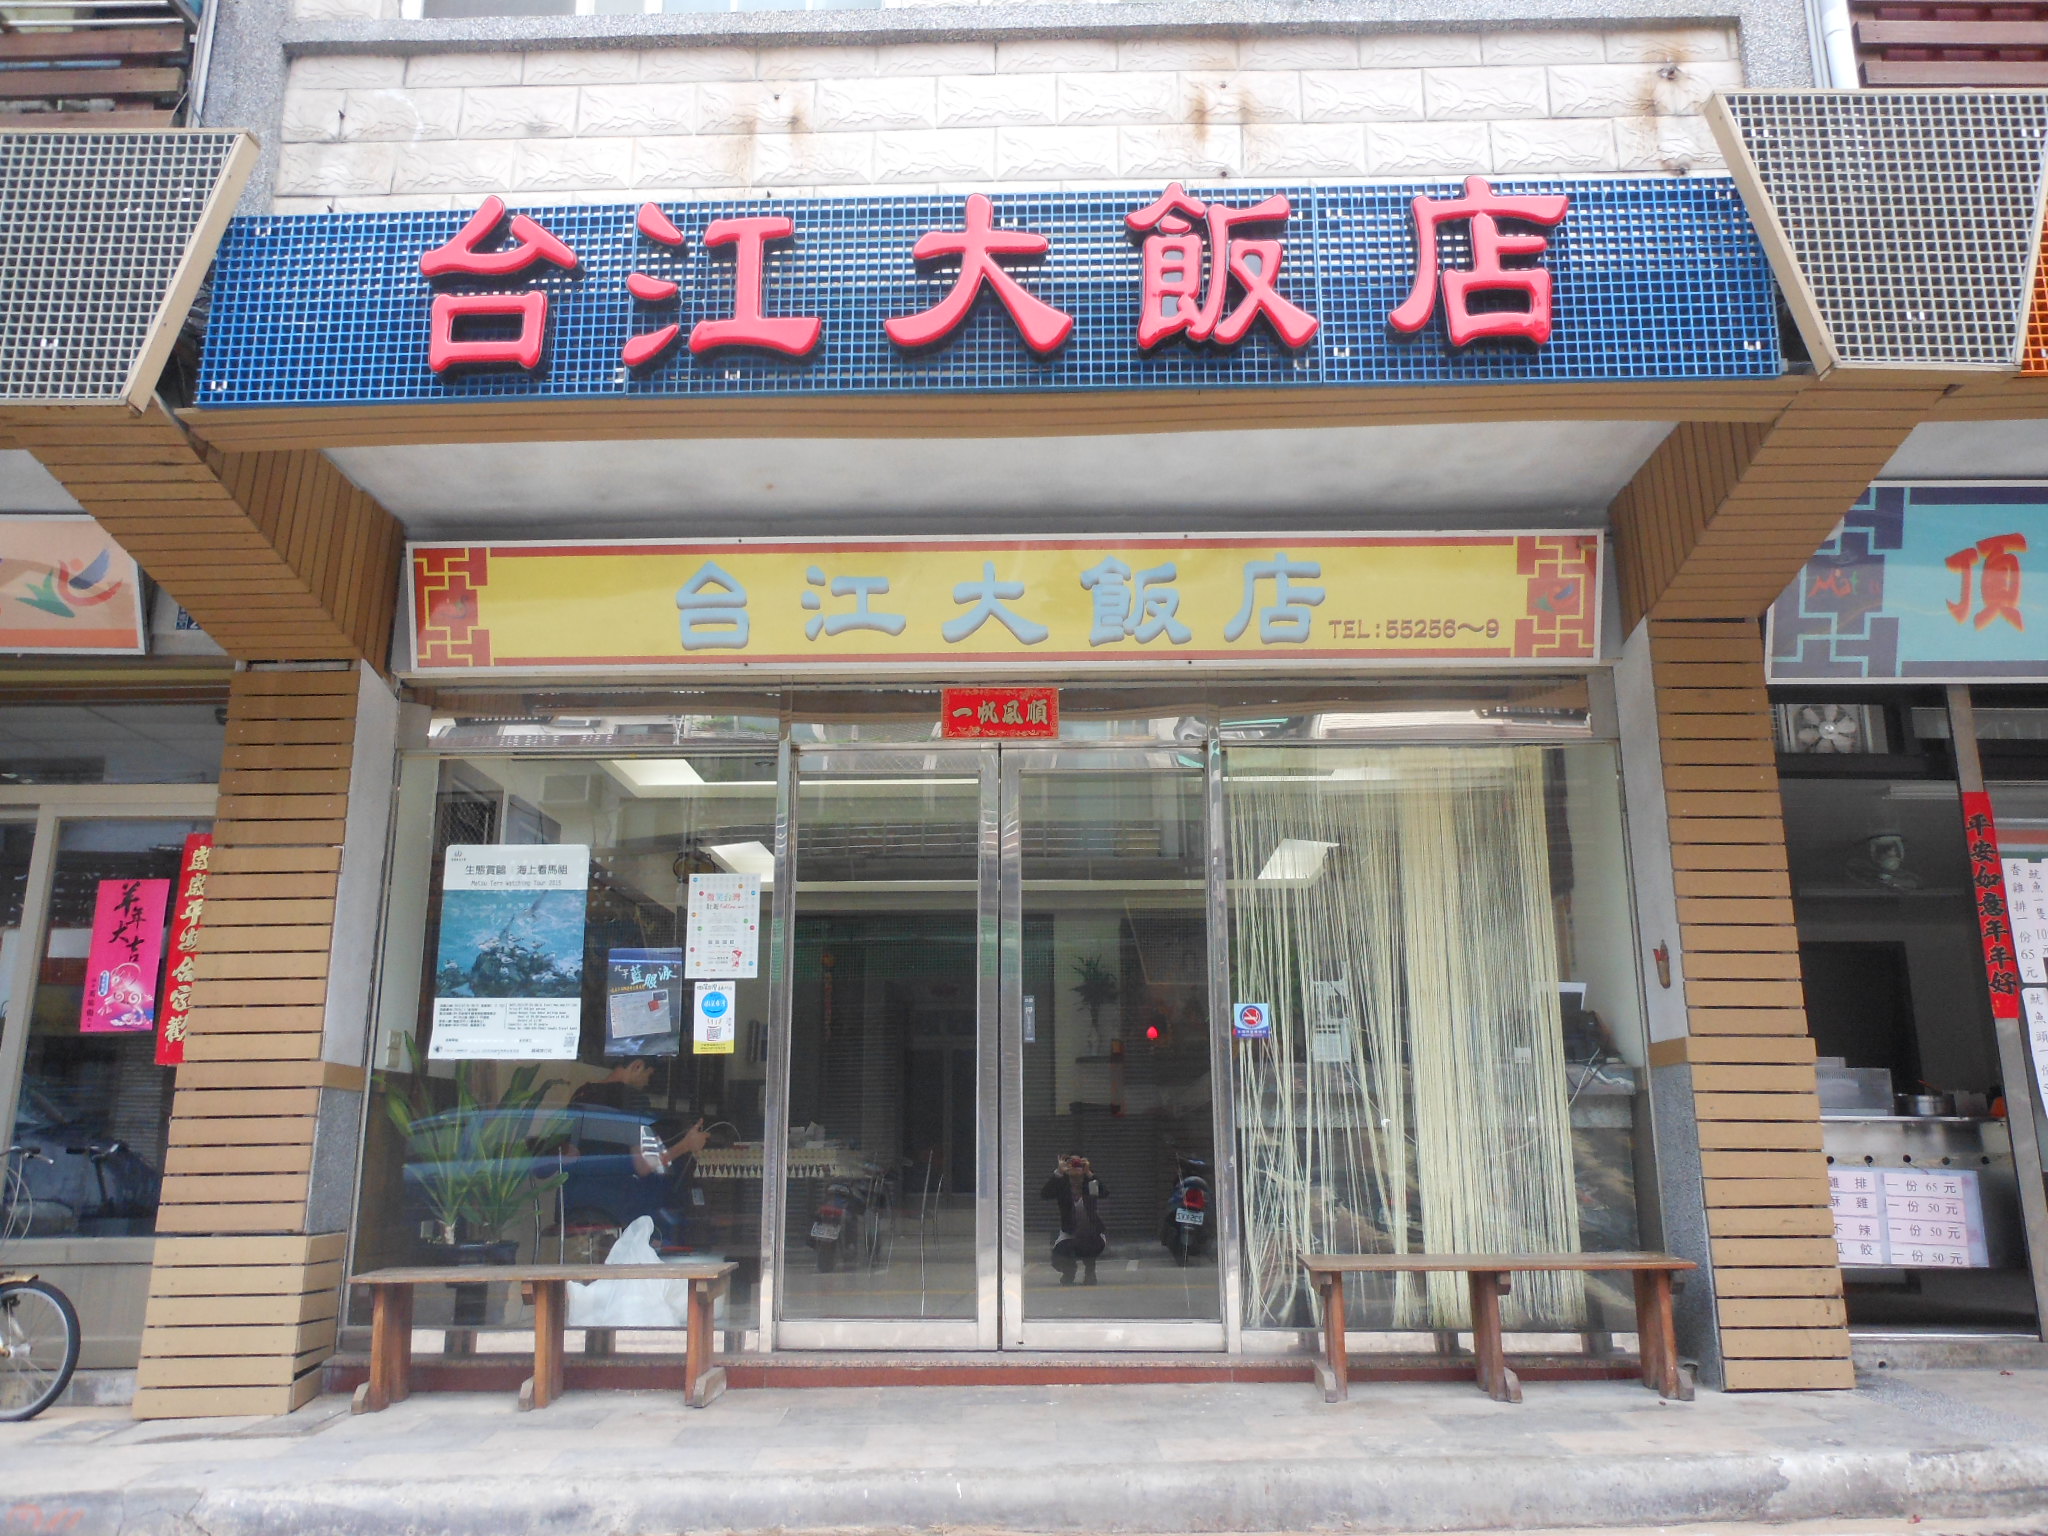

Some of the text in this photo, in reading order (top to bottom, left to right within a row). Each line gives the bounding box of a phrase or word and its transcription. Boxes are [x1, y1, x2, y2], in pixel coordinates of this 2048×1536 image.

[419, 176, 1570, 374] 台江大飯店
[676, 552, 1326, 650] 台江大飯店
[1945, 533, 2028, 632] 頂
[952, 699, 1049, 725] 一帆風順
[108, 880, 147, 962] 羊年大吉
[1965, 813, 2018, 994] 平安如意年年好
[1886, 1180, 1957, 1194] 一份65元
[1888, 1201, 1959, 1215] 一份50元
[1890, 1225, 1961, 1240] 一份50元
[1892, 1250, 1963, 1265] 一份50元
